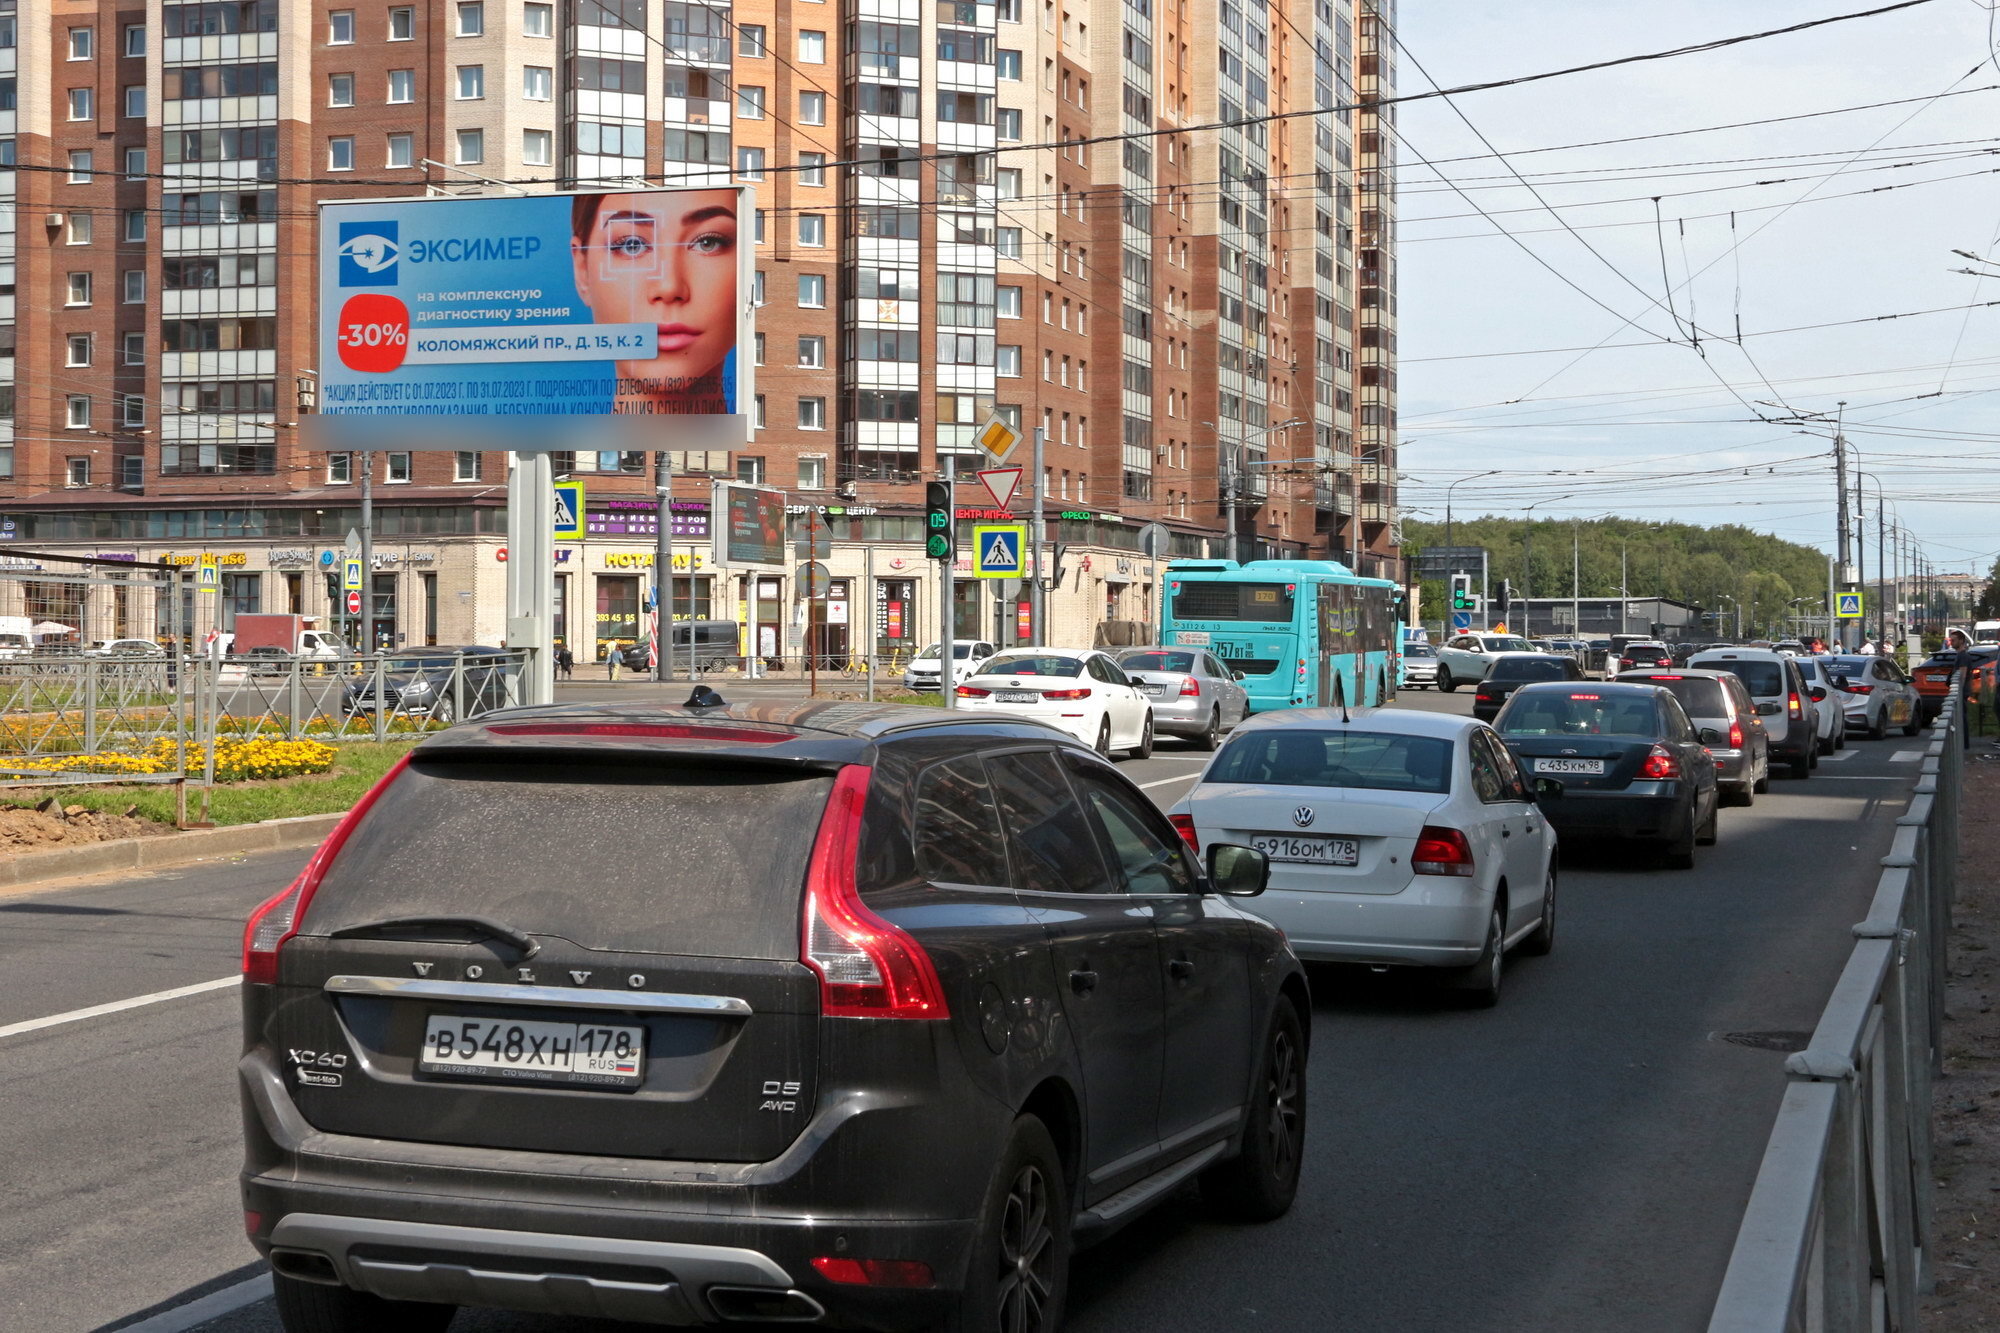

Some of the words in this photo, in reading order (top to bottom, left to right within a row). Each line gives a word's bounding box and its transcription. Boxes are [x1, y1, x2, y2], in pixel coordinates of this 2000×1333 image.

[408, 236, 542, 264] ЭКСИМЕР
[416, 291, 435, 303] на
[438, 288, 542, 305] комплексную
[416, 308, 512, 323] диагностику
[515, 306, 570, 320] зрения
[338, 322, 406, 347] -30%
[416, 335, 539, 352] КОЛОМЯЖСКИЙ
[544, 337, 572, 350] ПР.,
[575, 336, 590, 350] Д.
[594, 336, 612, 349] 15,
[617, 335, 630, 347] К.
[634, 335, 643, 347] 2
[357, 381, 403, 402] ДЕЙСТВУЕТ
[405, 383, 411, 399] С
[412, 382, 457, 399] 01.07.2023
[459, 382, 465, 398] Г.
[467, 381, 479, 398] ПО
[480, 380, 525, 398] 31.07.2023
[526, 380, 532, 396] Г.
[535, 378, 600, 398] ПОДРОБНОСТИ
[602, 378, 612, 396] ПО
[615, 377, 663, 396] ТЕЛЕФОНУ:
[664, 375, 685, 394] (812)
[846, 506, 877, 516] ЦЕНТР
[931, 514, 946, 528] 05
[414, 552, 434, 561] БАНК
[605, 552, 703, 567] НОТАИУС
[1588, 760, 1600, 770] 98
[1328, 841, 1352, 855] 178
[412, 961, 646, 989] VOLVO
[435, 1022, 571, 1067] В548ХН
[580, 1028, 632, 1060] 178
[287, 1048, 347, 1069] XC60
[588, 1058, 615, 1070] RUS
[432, 1064, 450, 1072] (812)
[452, 1064, 488, 1074] 920-89-72
[502, 1069, 517, 1078] СТО
[568, 1073, 586, 1082] (812)
[762, 1080, 801, 1095] D5
[759, 1100, 796, 1112] AWD
